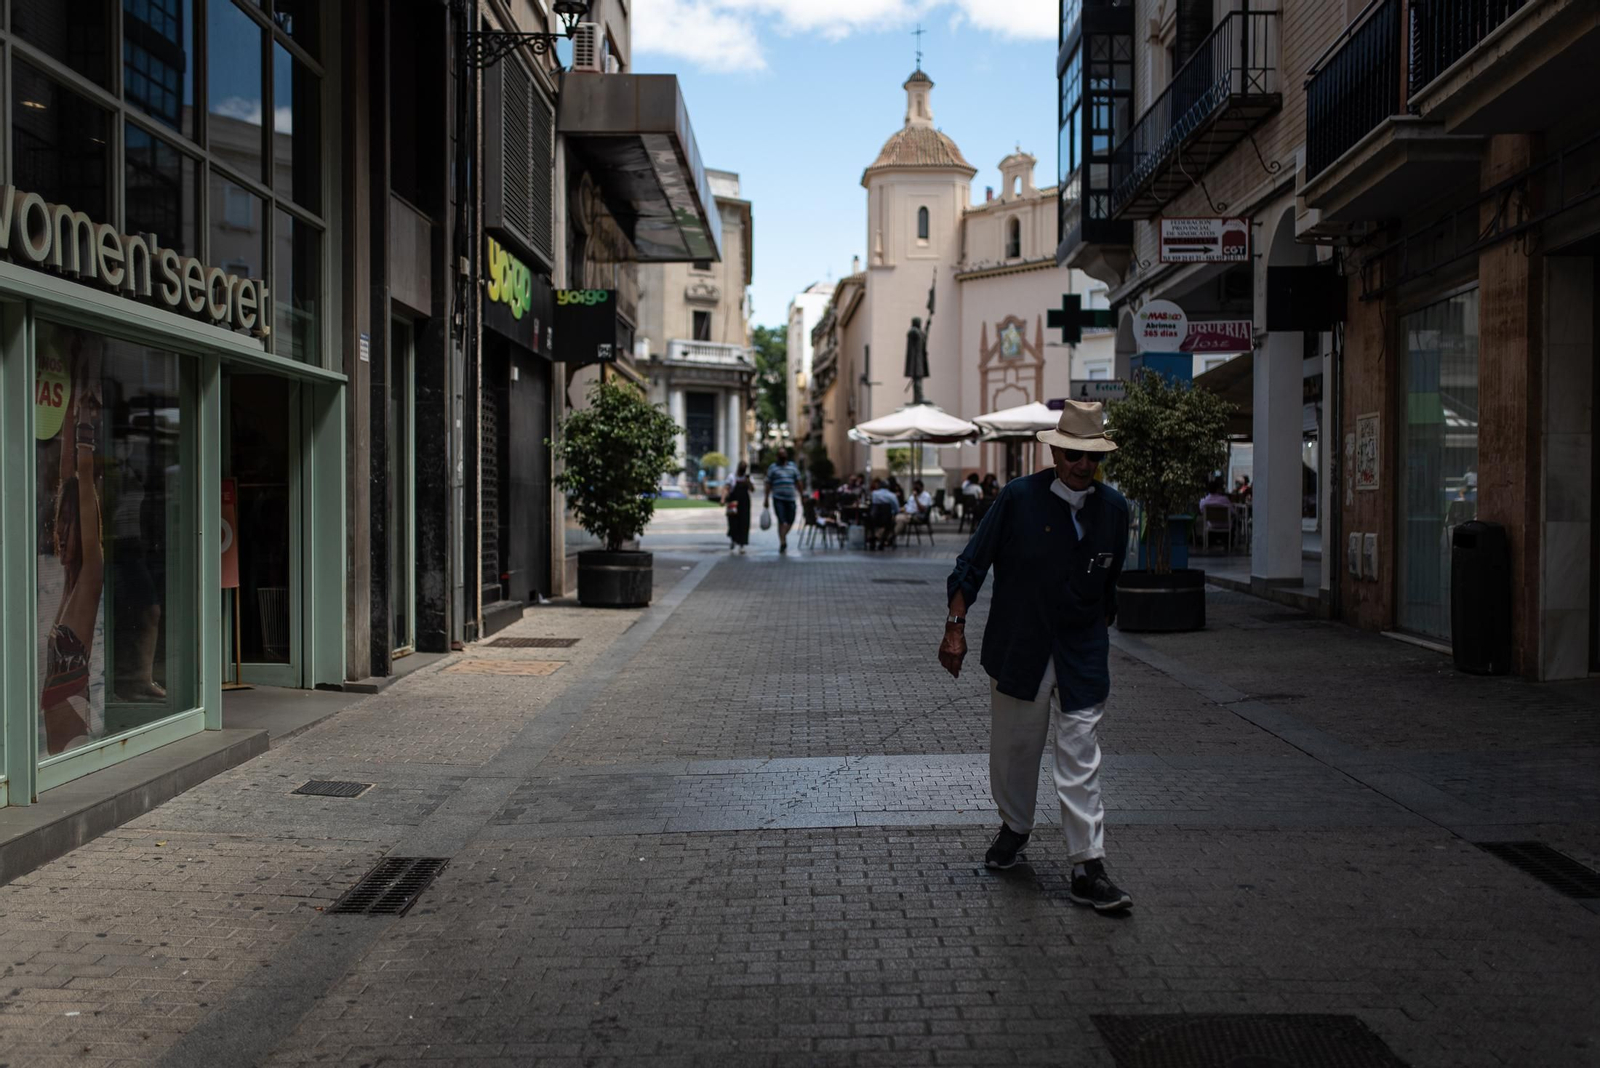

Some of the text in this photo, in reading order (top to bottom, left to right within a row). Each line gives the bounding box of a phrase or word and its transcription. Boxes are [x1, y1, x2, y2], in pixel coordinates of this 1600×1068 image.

[1223, 245, 1245, 254] CGT
[487, 236, 532, 320] yoigo
[556, 290, 609, 306] yoigo
